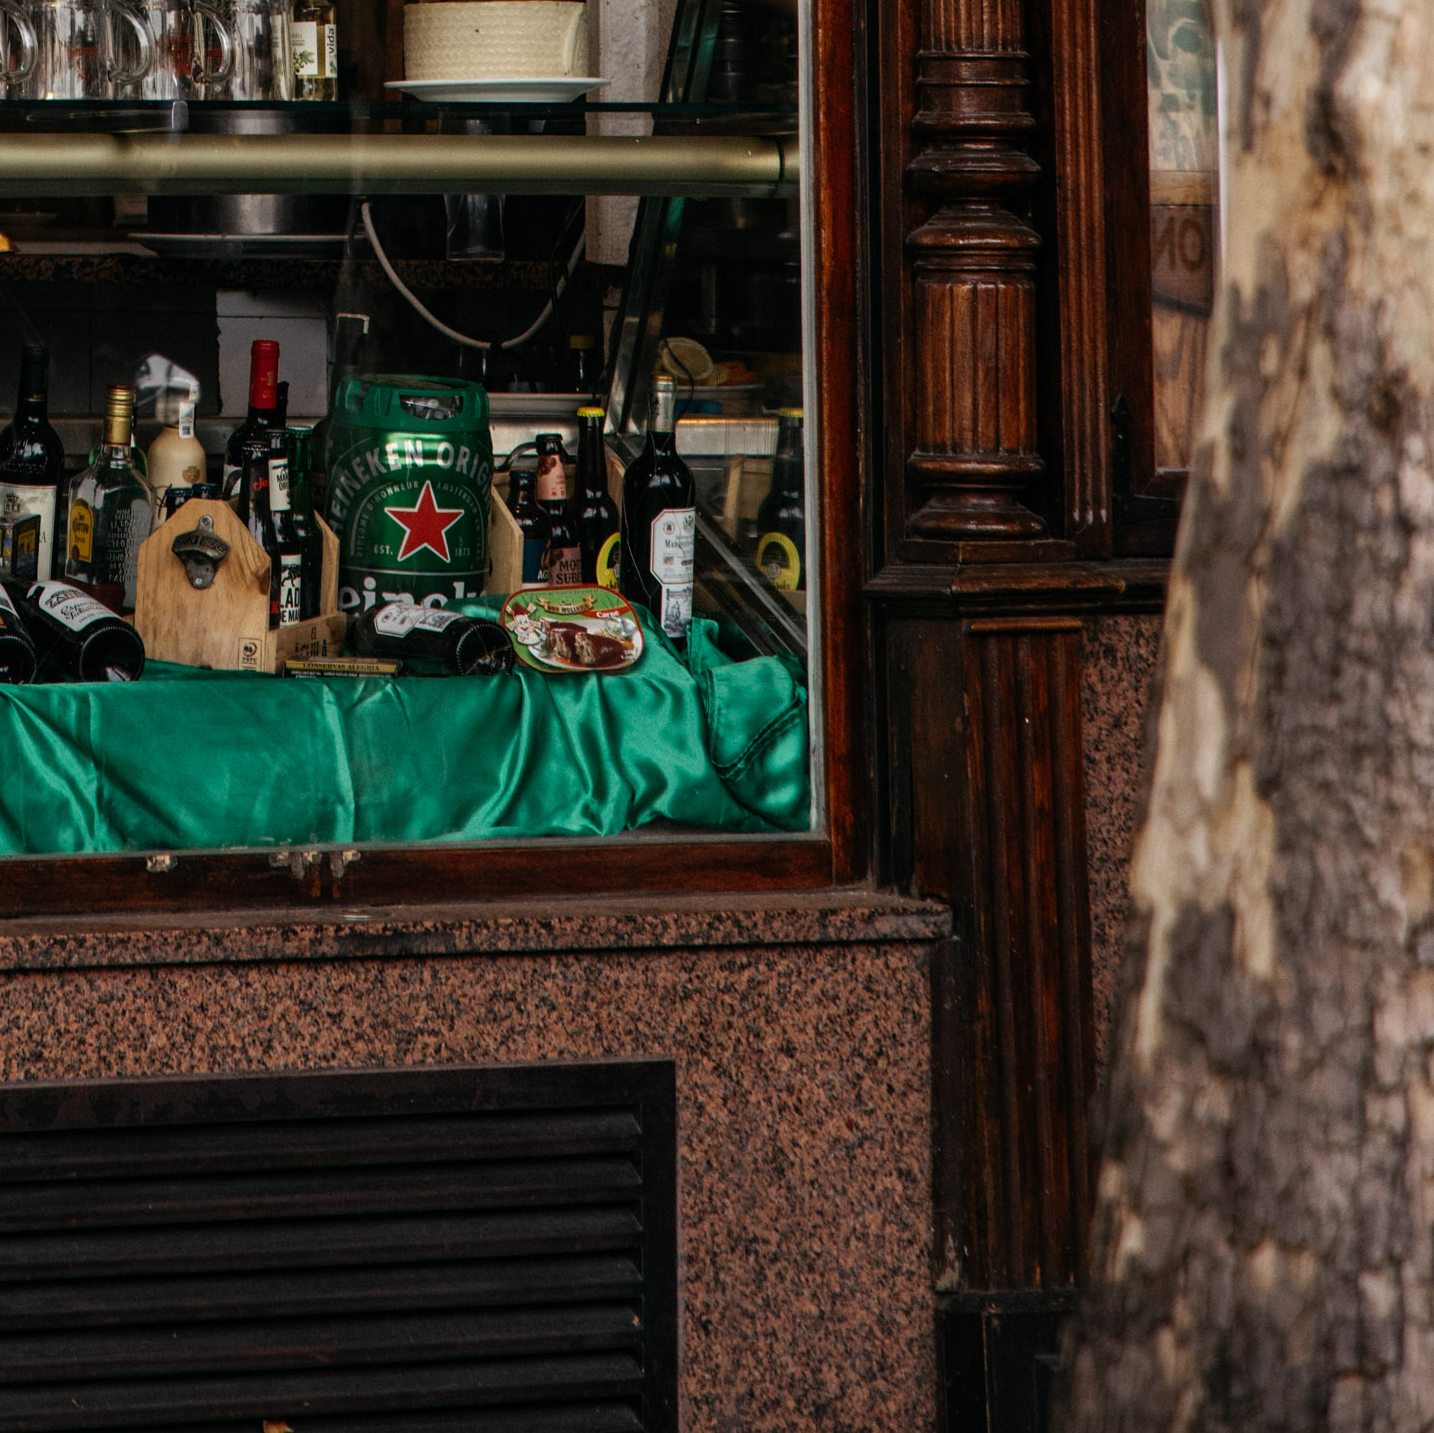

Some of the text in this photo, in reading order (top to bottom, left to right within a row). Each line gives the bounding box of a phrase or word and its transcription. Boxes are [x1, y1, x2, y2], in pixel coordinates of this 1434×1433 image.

[326, 27, 335, 54] vida
[329, 440, 424, 539] HEINEKEN
[374, 544, 394, 556] EST.
[596, 611, 620, 619] Carne
[303, 662, 346, 671] CONSERVAS
